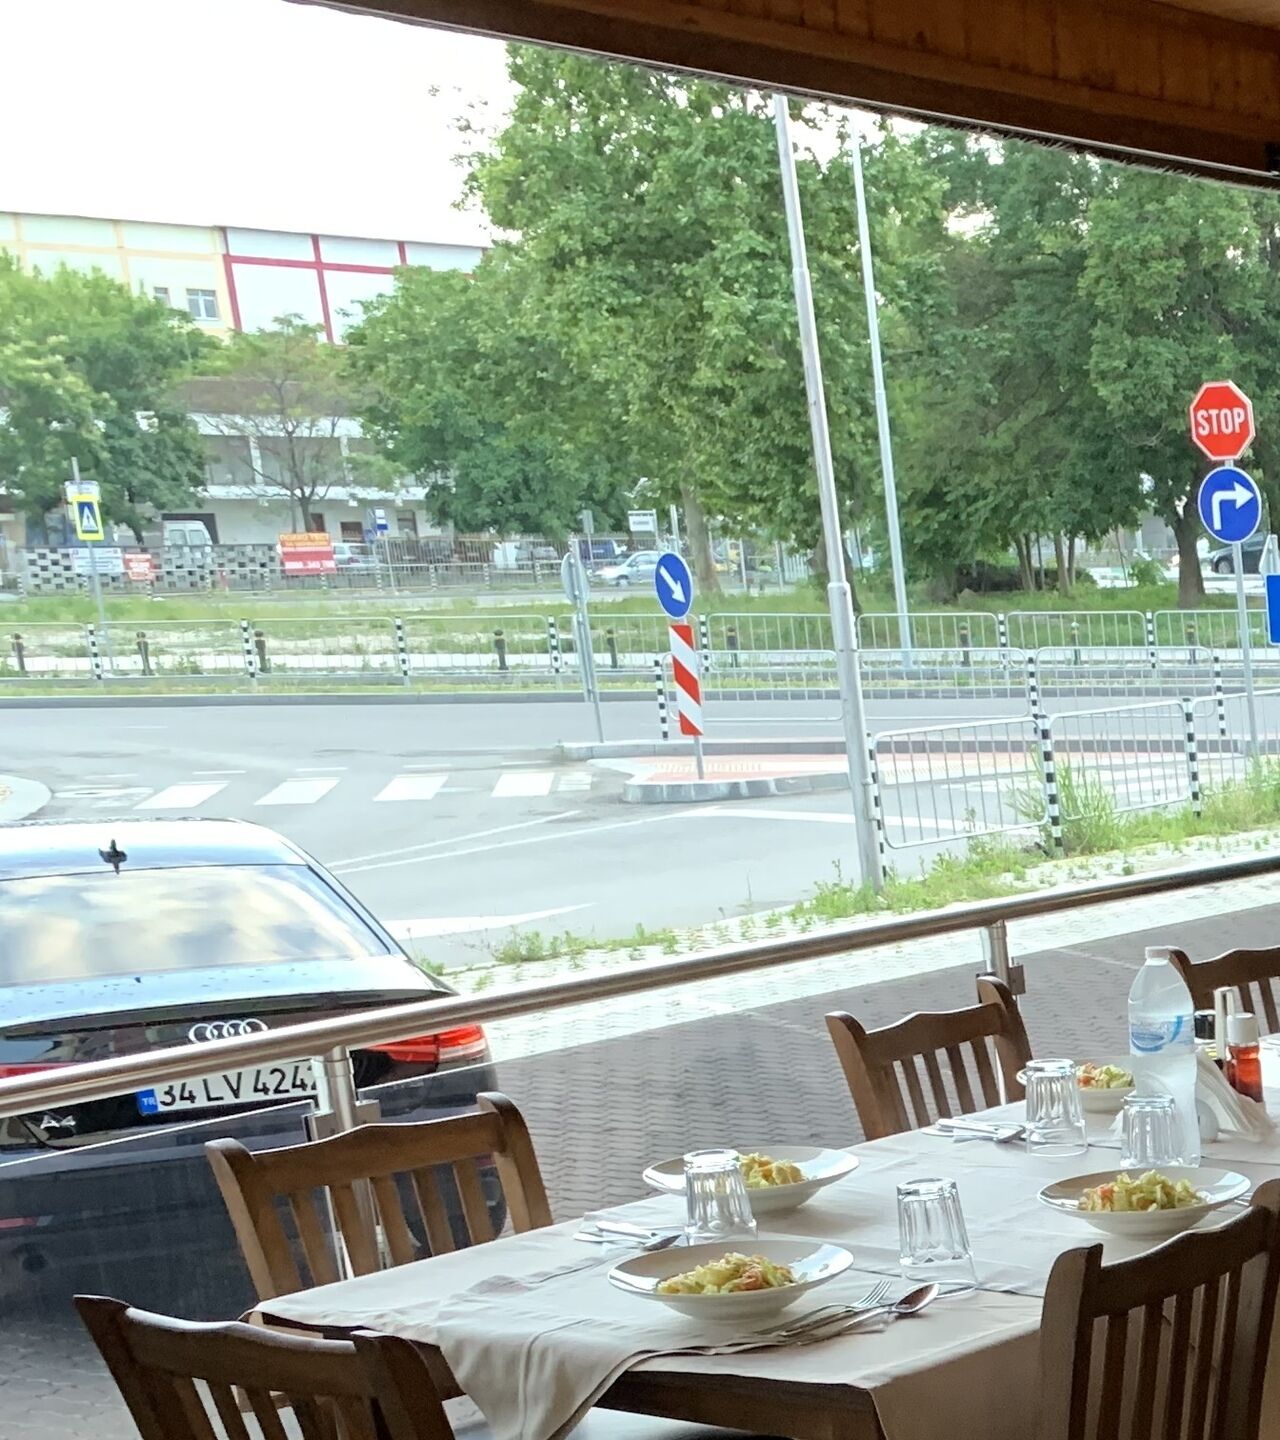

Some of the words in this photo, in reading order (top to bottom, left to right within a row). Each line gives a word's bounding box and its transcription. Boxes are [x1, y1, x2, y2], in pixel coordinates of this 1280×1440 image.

[1197, 407, 1245, 436] STOP
[159, 1082, 197, 1107] 34
[202, 1071, 243, 1102] LV
[141, 1096, 156, 1106] TR
[40, 1114, 76, 1130] A4
